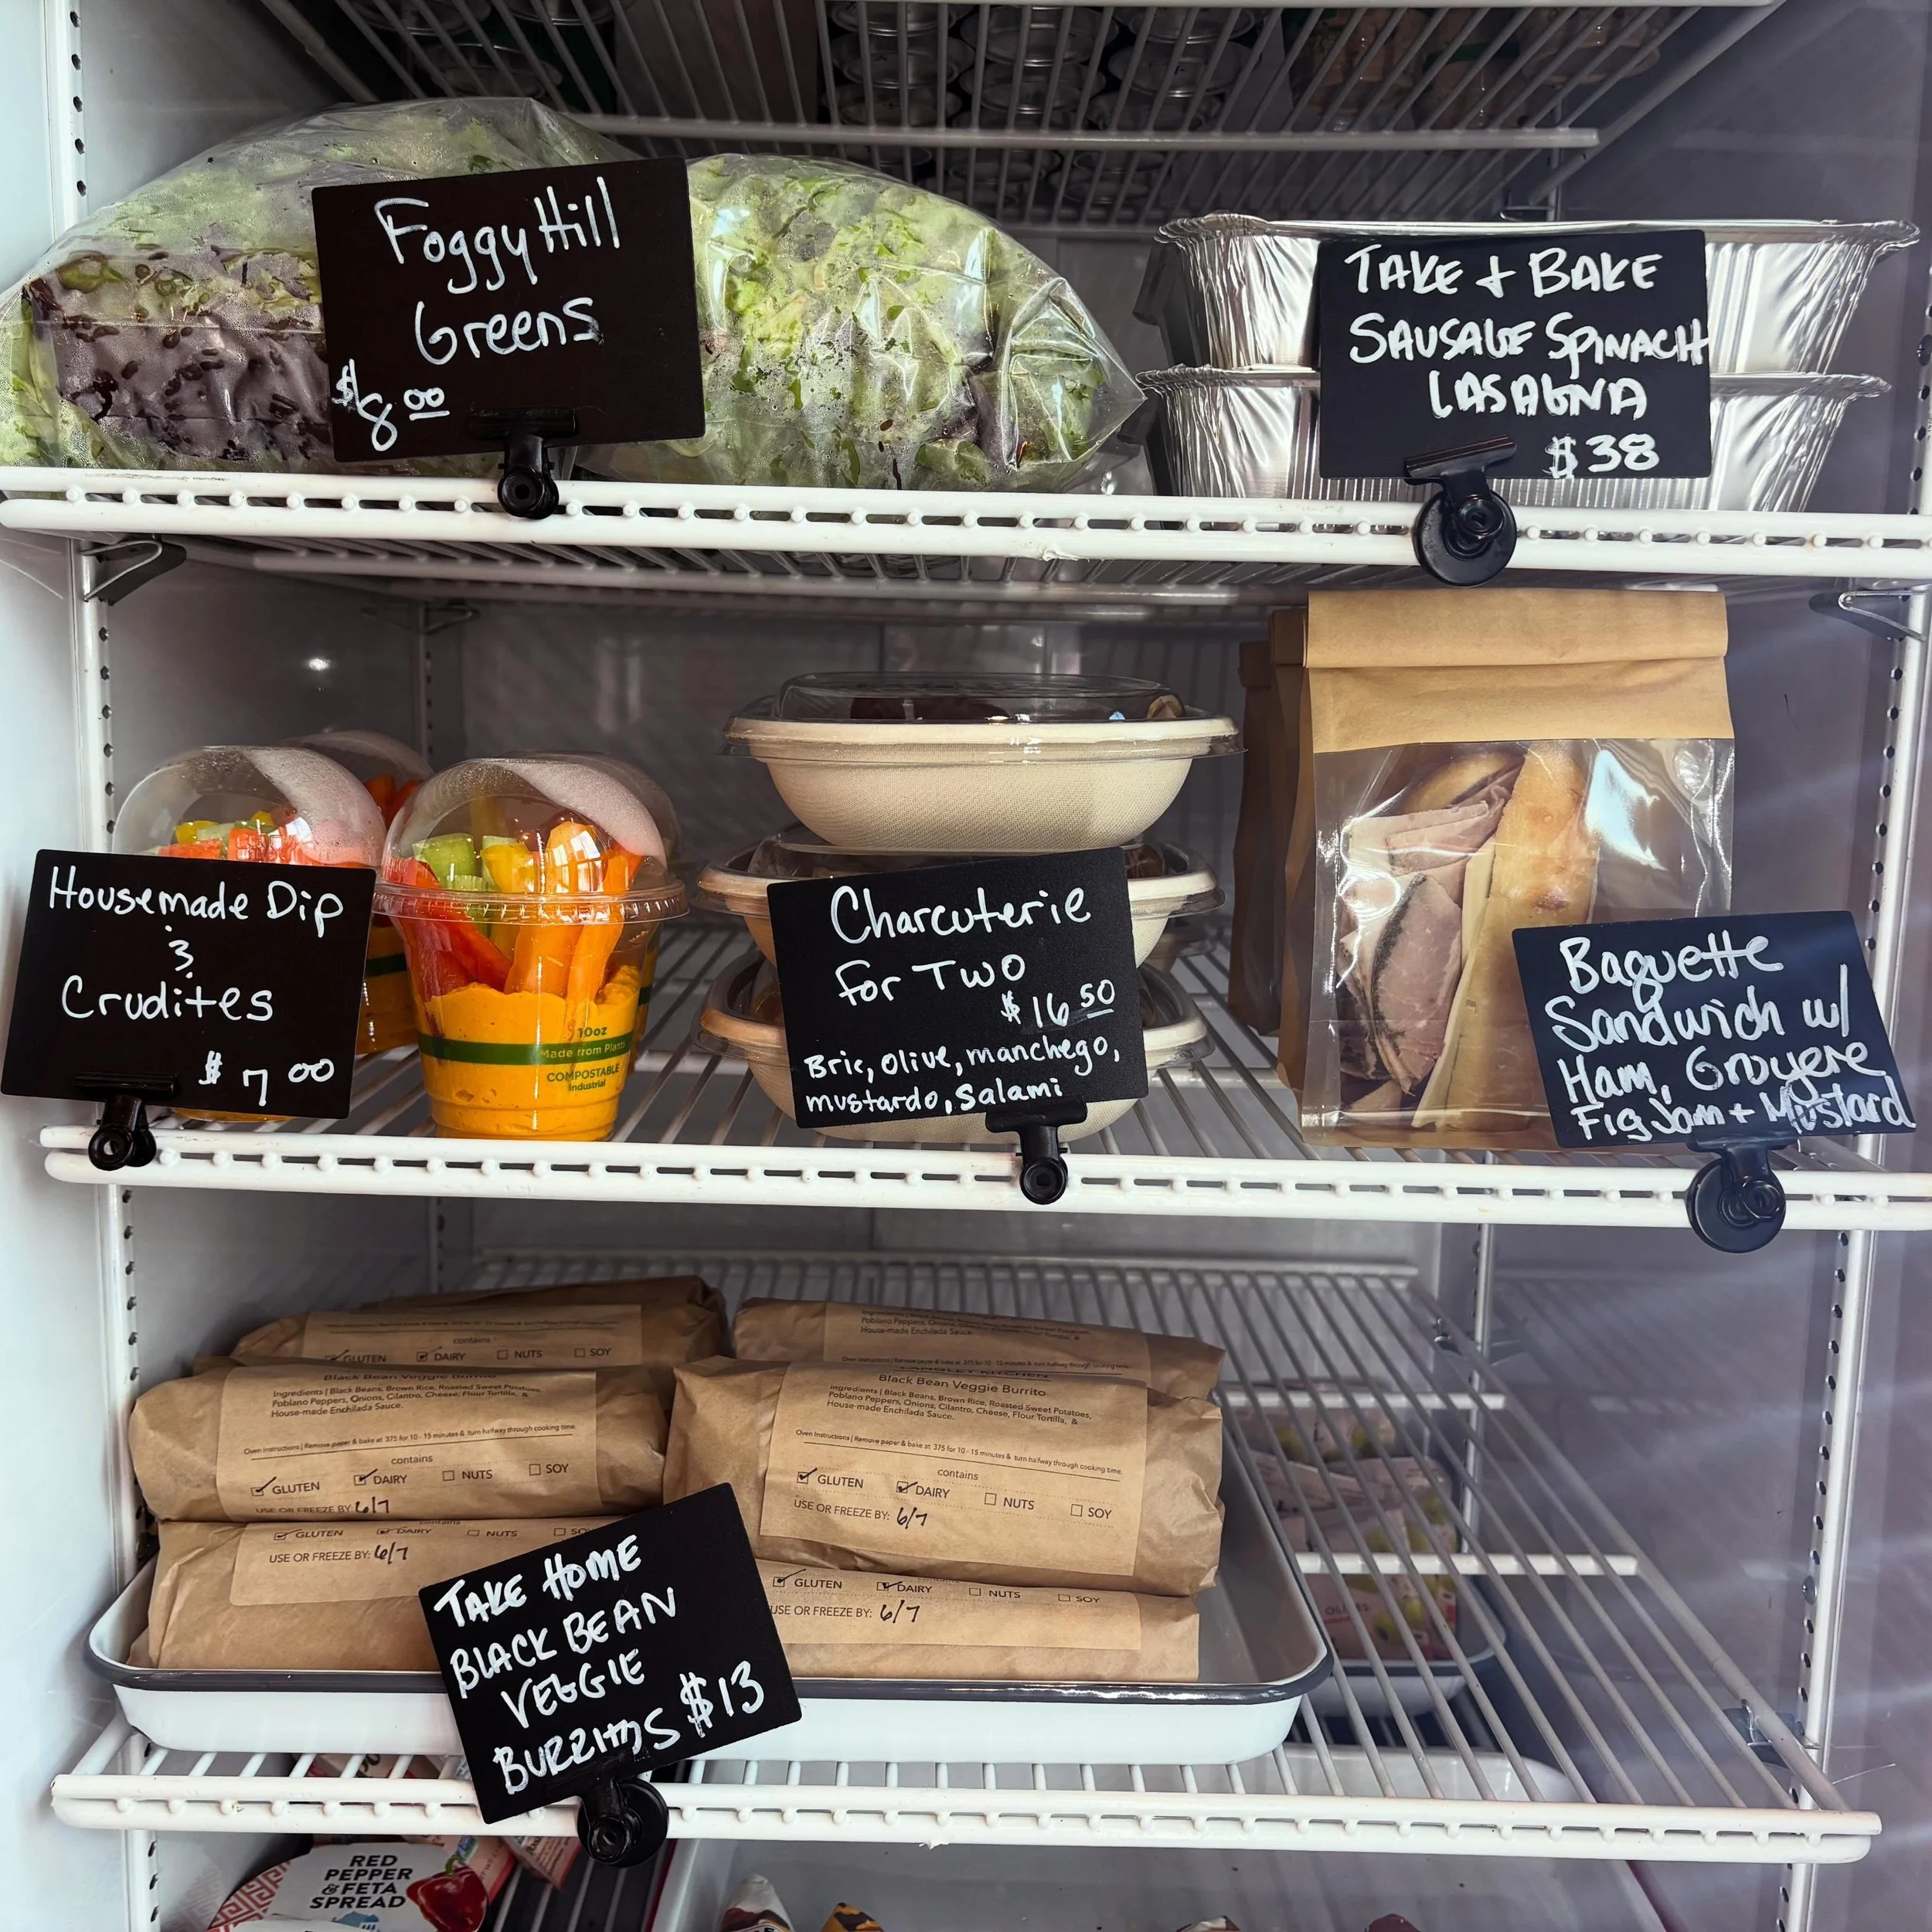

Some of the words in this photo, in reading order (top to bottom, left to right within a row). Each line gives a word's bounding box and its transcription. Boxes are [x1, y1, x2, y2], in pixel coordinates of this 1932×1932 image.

[374, 198, 538, 294] Foggy
[534, 176, 620, 253] Hill
[1345, 244, 1464, 294] TAKE
[1529, 247, 1663, 298] BAKE
[415, 298, 604, 365] Greens
[1349, 312, 1536, 363] SAUSAGE
[1546, 312, 1709, 379] SPINACH
[1429, 370, 1648, 420] LASAGNA
[49, 866, 249, 919] Housemade
[267, 880, 343, 937] Dip
[830, 886, 1091, 944] Charcuterie
[1560, 930, 1785, 1013] Baguette
[62, 975, 274, 1022] Crudites
[1545, 985, 1786, 1053] Sandwich
[1802, 964, 1849, 1037] w/
[577, 1026, 608, 1038] 10oz
[546, 1063, 621, 1082] COMPOSTABLE
[881, 1046, 964, 1077] Olive,
[568, 1079, 607, 1091] Industrial
[955, 1078, 1063, 1111] Salami
[434, 1352, 466, 1362] DAIRY
[514, 1350, 543, 1359] NUTS
[590, 1348, 611, 1357] SOY
[879, 1374, 913, 1385] Black
[917, 1377, 949, 1388] Bean
[953, 1380, 998, 1393] Veggie
[1002, 1384, 1046, 1397] Burrito
[827, 1400, 881, 1412] House-made
[883, 1406, 924, 1417] Enchilada
[927, 1410, 955, 1420] Sauce.
[828, 1391, 864, 1401] Poblano
[866, 1395, 902, 1406] Peppers,
[976, 1407, 1011, 1419] Cheese,
[1012, 1411, 1035, 1420] Flour
[1036, 1413, 1067, 1425] Tortilla,
[830, 1385, 878, 1394] Ingredients
[938, 1395, 965, 1403] Brown
[989, 1400, 1024, 1410] Roasted
[1026, 1404, 1051, 1413] Sweet
[1053, 1407, 1092, 1420] Potatoes,
[391, 1454, 433, 1465] contains
[814, 1430, 850, 1441] Instructions
[854, 1435, 879, 1444] Remove
[907, 1440, 923, 1449] bake
[1028, 1456, 1052, 1466] halfway
[1053, 1459, 1079, 1470] through
[1080, 1464, 1106, 1474] cooking
[272, 1481, 320, 1495] GLUTEN
[373, 1475, 407, 1485] DAIRY
[461, 1470, 493, 1480] NUTS
[546, 1464, 569, 1474] SOY
[937, 1469, 979, 1481] contains
[818, 1474, 864, 1488] GLUTEN
[916, 1485, 951, 1498] DAIRY
[1003, 1496, 1035, 1510] NUTS
[1087, 1507, 1112, 1519] SOY
[794, 1499, 814, 1510] USE
[816, 1503, 832, 1513] OR
[834, 1505, 872, 1518] FREEZE
[874, 1510, 890, 1521] BY:
[896, 1506, 928, 1529] 6/7
[295, 1529, 344, 1539] GLUTEN
[269, 1554, 291, 1563] USE
[293, 1553, 310, 1562] OR
[312, 1551, 352, 1561] FREEZE
[354, 1550, 372, 1560] BY:
[374, 1541, 409, 1566] 6/7
[434, 1573, 527, 1628] TAKE
[542, 1534, 642, 1601] HOME
[794, 1578, 842, 1589] GLUTEN
[896, 1583, 933, 1594] DAIRY
[988, 1590, 1021, 1599] NUTS
[770, 1605, 791, 1615] USE
[794, 1605, 810, 1616] OR
[813, 1606, 853, 1617] FREEZE
[855, 1607, 872, 1618] BY:
[879, 1599, 920, 1624] 6/7
[449, 1628, 557, 1699] BLACK
[563, 1587, 675, 1655] BEAN
[501, 1648, 645, 1730] VEGGIE
[679, 1660, 765, 1739] $13
[324, 1868, 413, 1881] PEPPER
[349, 1855, 398, 1867] RED
[310, 1896, 406, 1909] SPREAD
[321, 1883, 339, 1896] &
[341, 1882, 397, 1895] FETA
